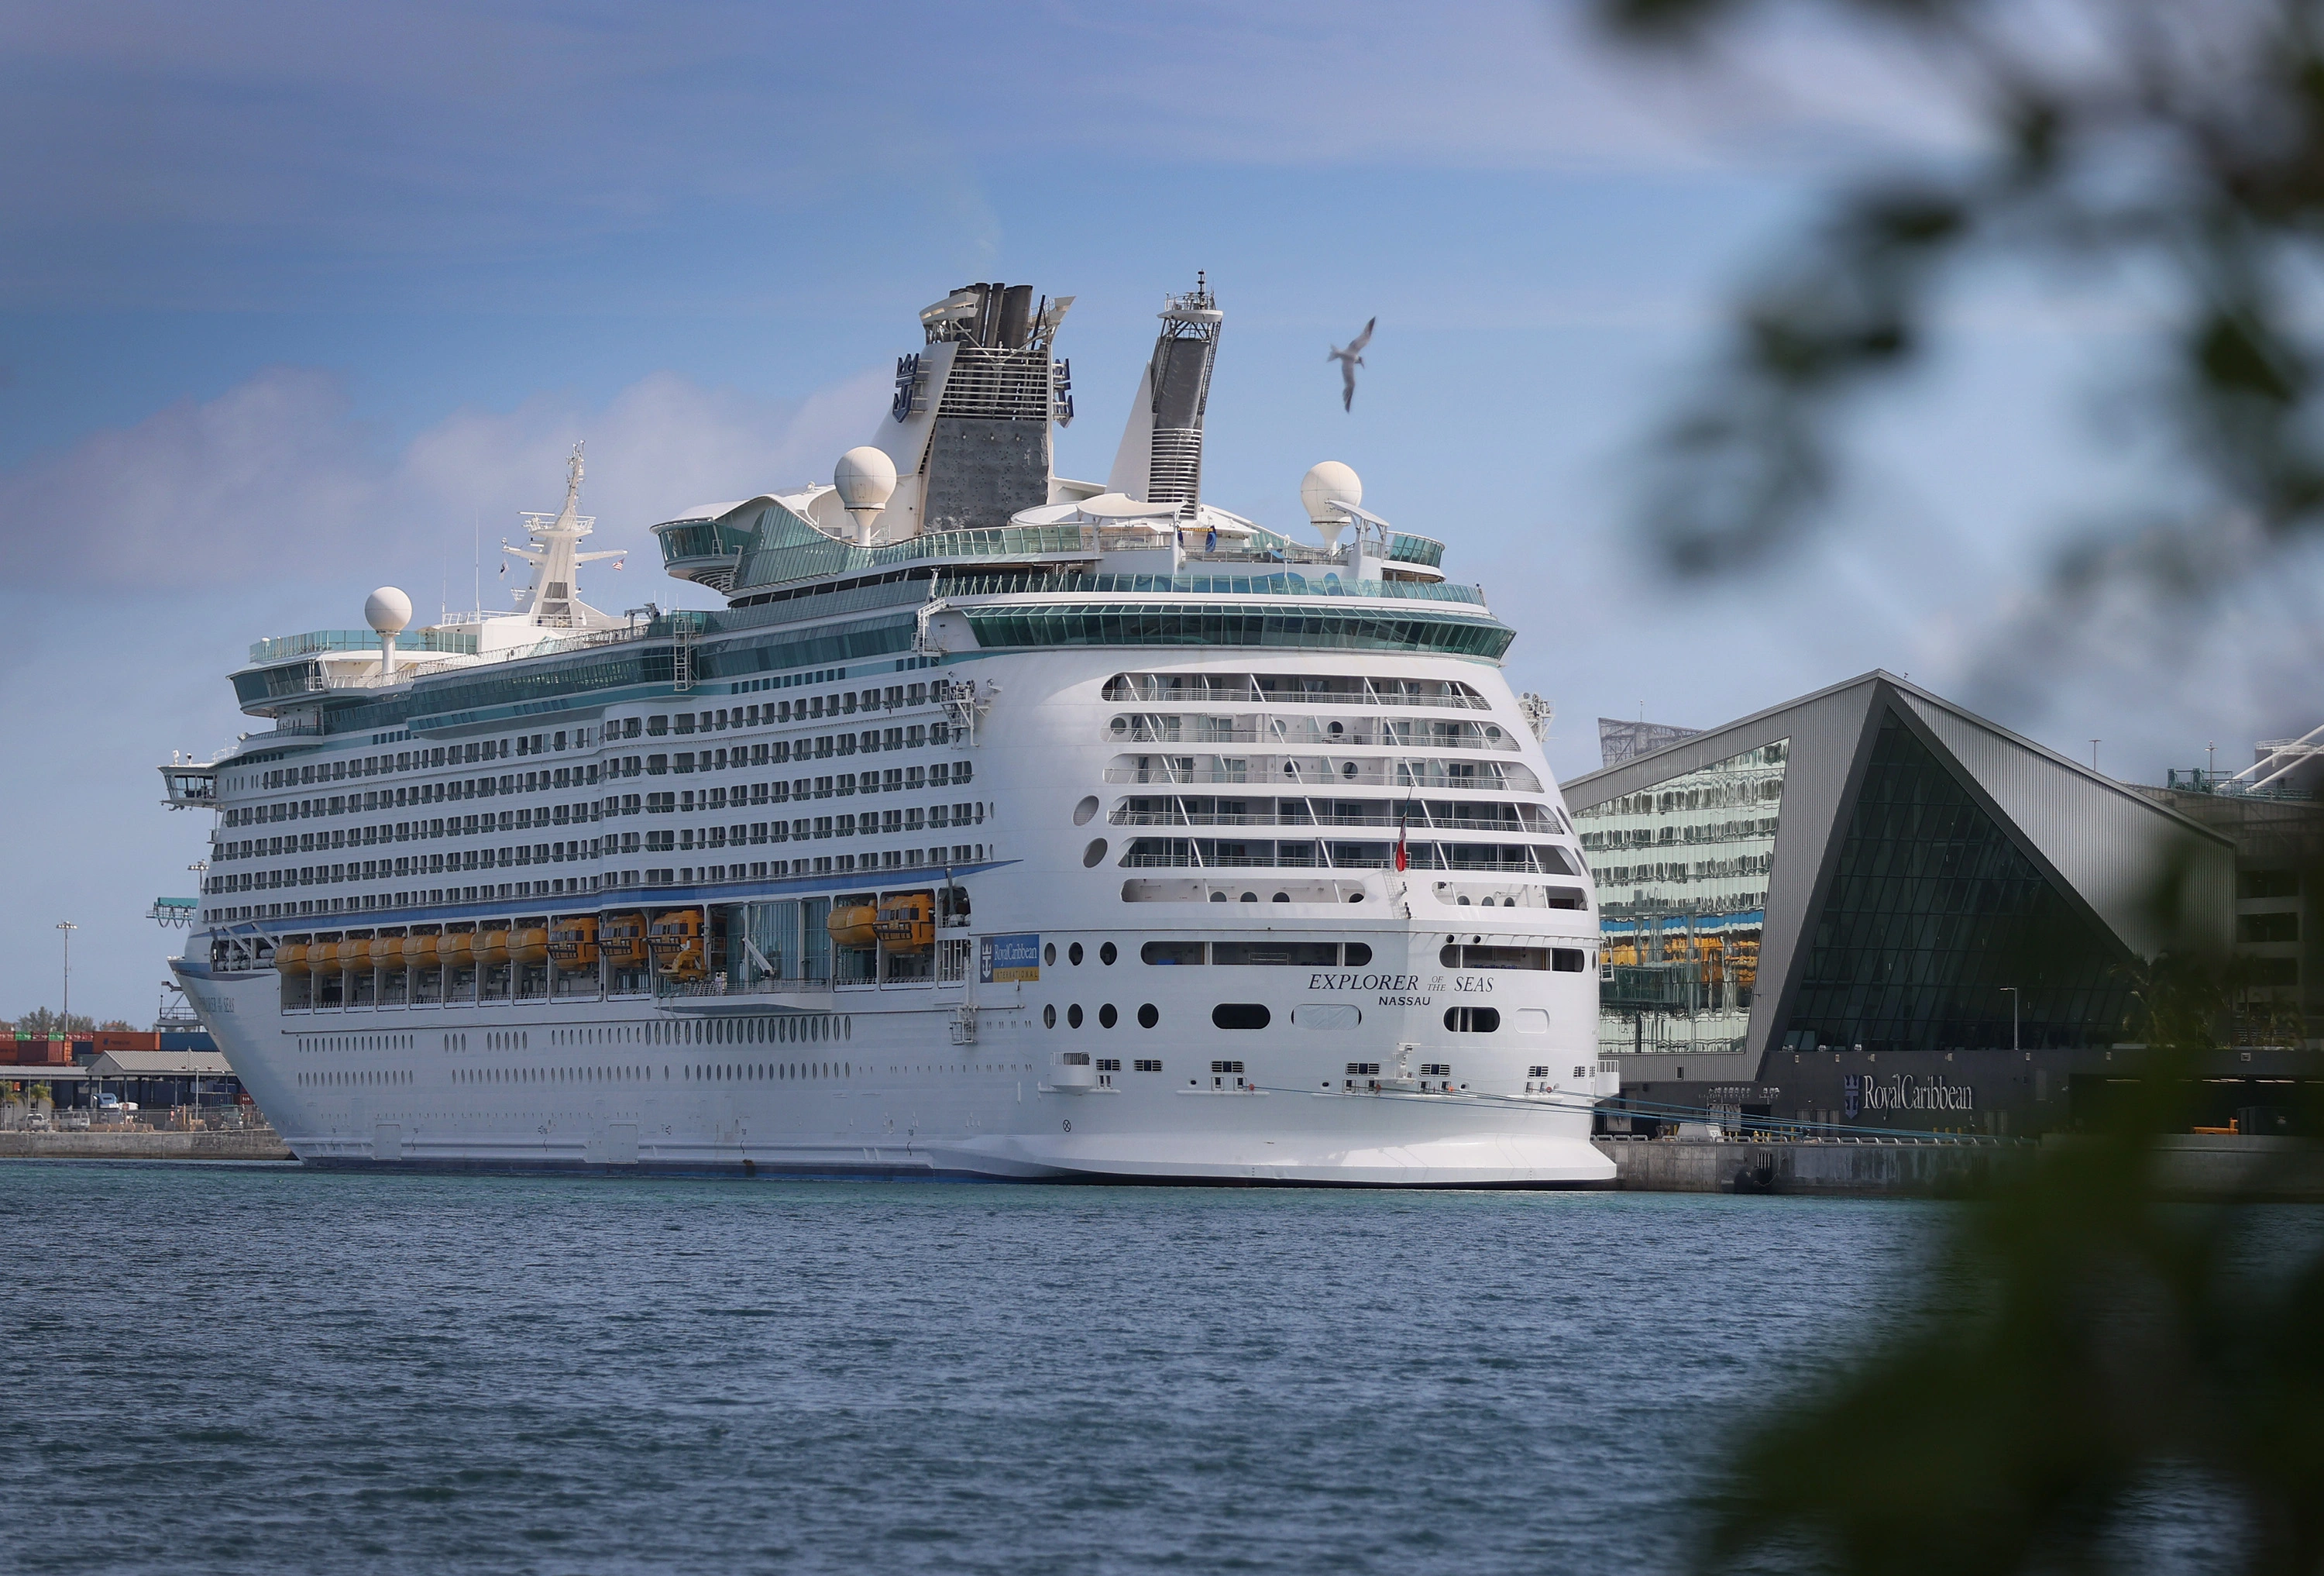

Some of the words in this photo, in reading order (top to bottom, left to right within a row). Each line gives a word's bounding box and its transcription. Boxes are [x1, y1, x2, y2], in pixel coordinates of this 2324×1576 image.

[995, 970, 1037, 979] INTERNATIONAL
[1308, 974, 1419, 990] EXPLORER
[1453, 976, 1494, 992] SEAS
[1427, 983, 1446, 992] THE
[1378, 996, 1431, 1006] NASSAU
[1863, 1074, 1973, 1120] RoyalCaribbean
